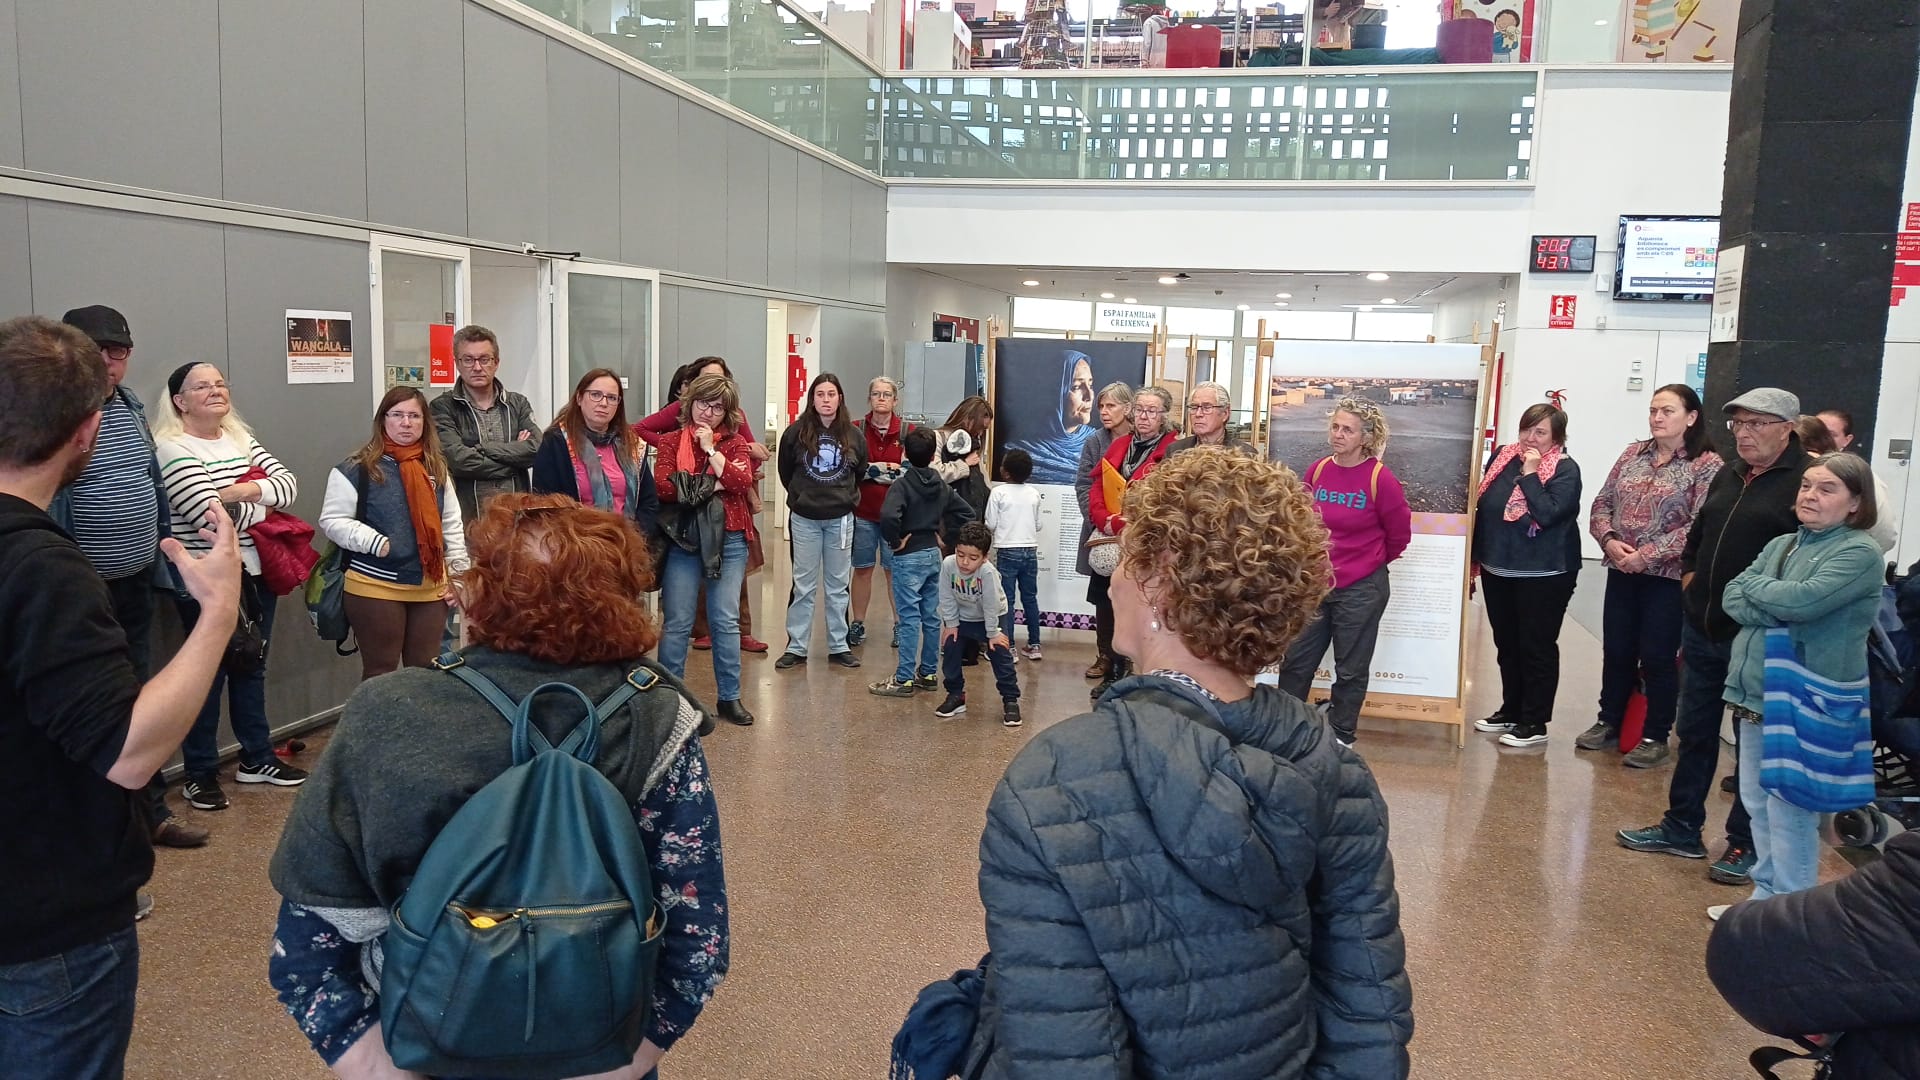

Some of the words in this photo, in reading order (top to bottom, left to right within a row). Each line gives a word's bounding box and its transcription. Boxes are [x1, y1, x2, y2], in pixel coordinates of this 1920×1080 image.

[1537, 239, 1571, 252] 20.2
[1103, 309, 1124, 317] ESPAI
[1125, 310, 1157, 319] FAMILIAR
[1110, 319, 1150, 328] CREIXENÇA
[291, 340, 342, 352] WANGALA
[432, 358, 443, 366] Sala
[432, 369, 448, 377] d'actes
